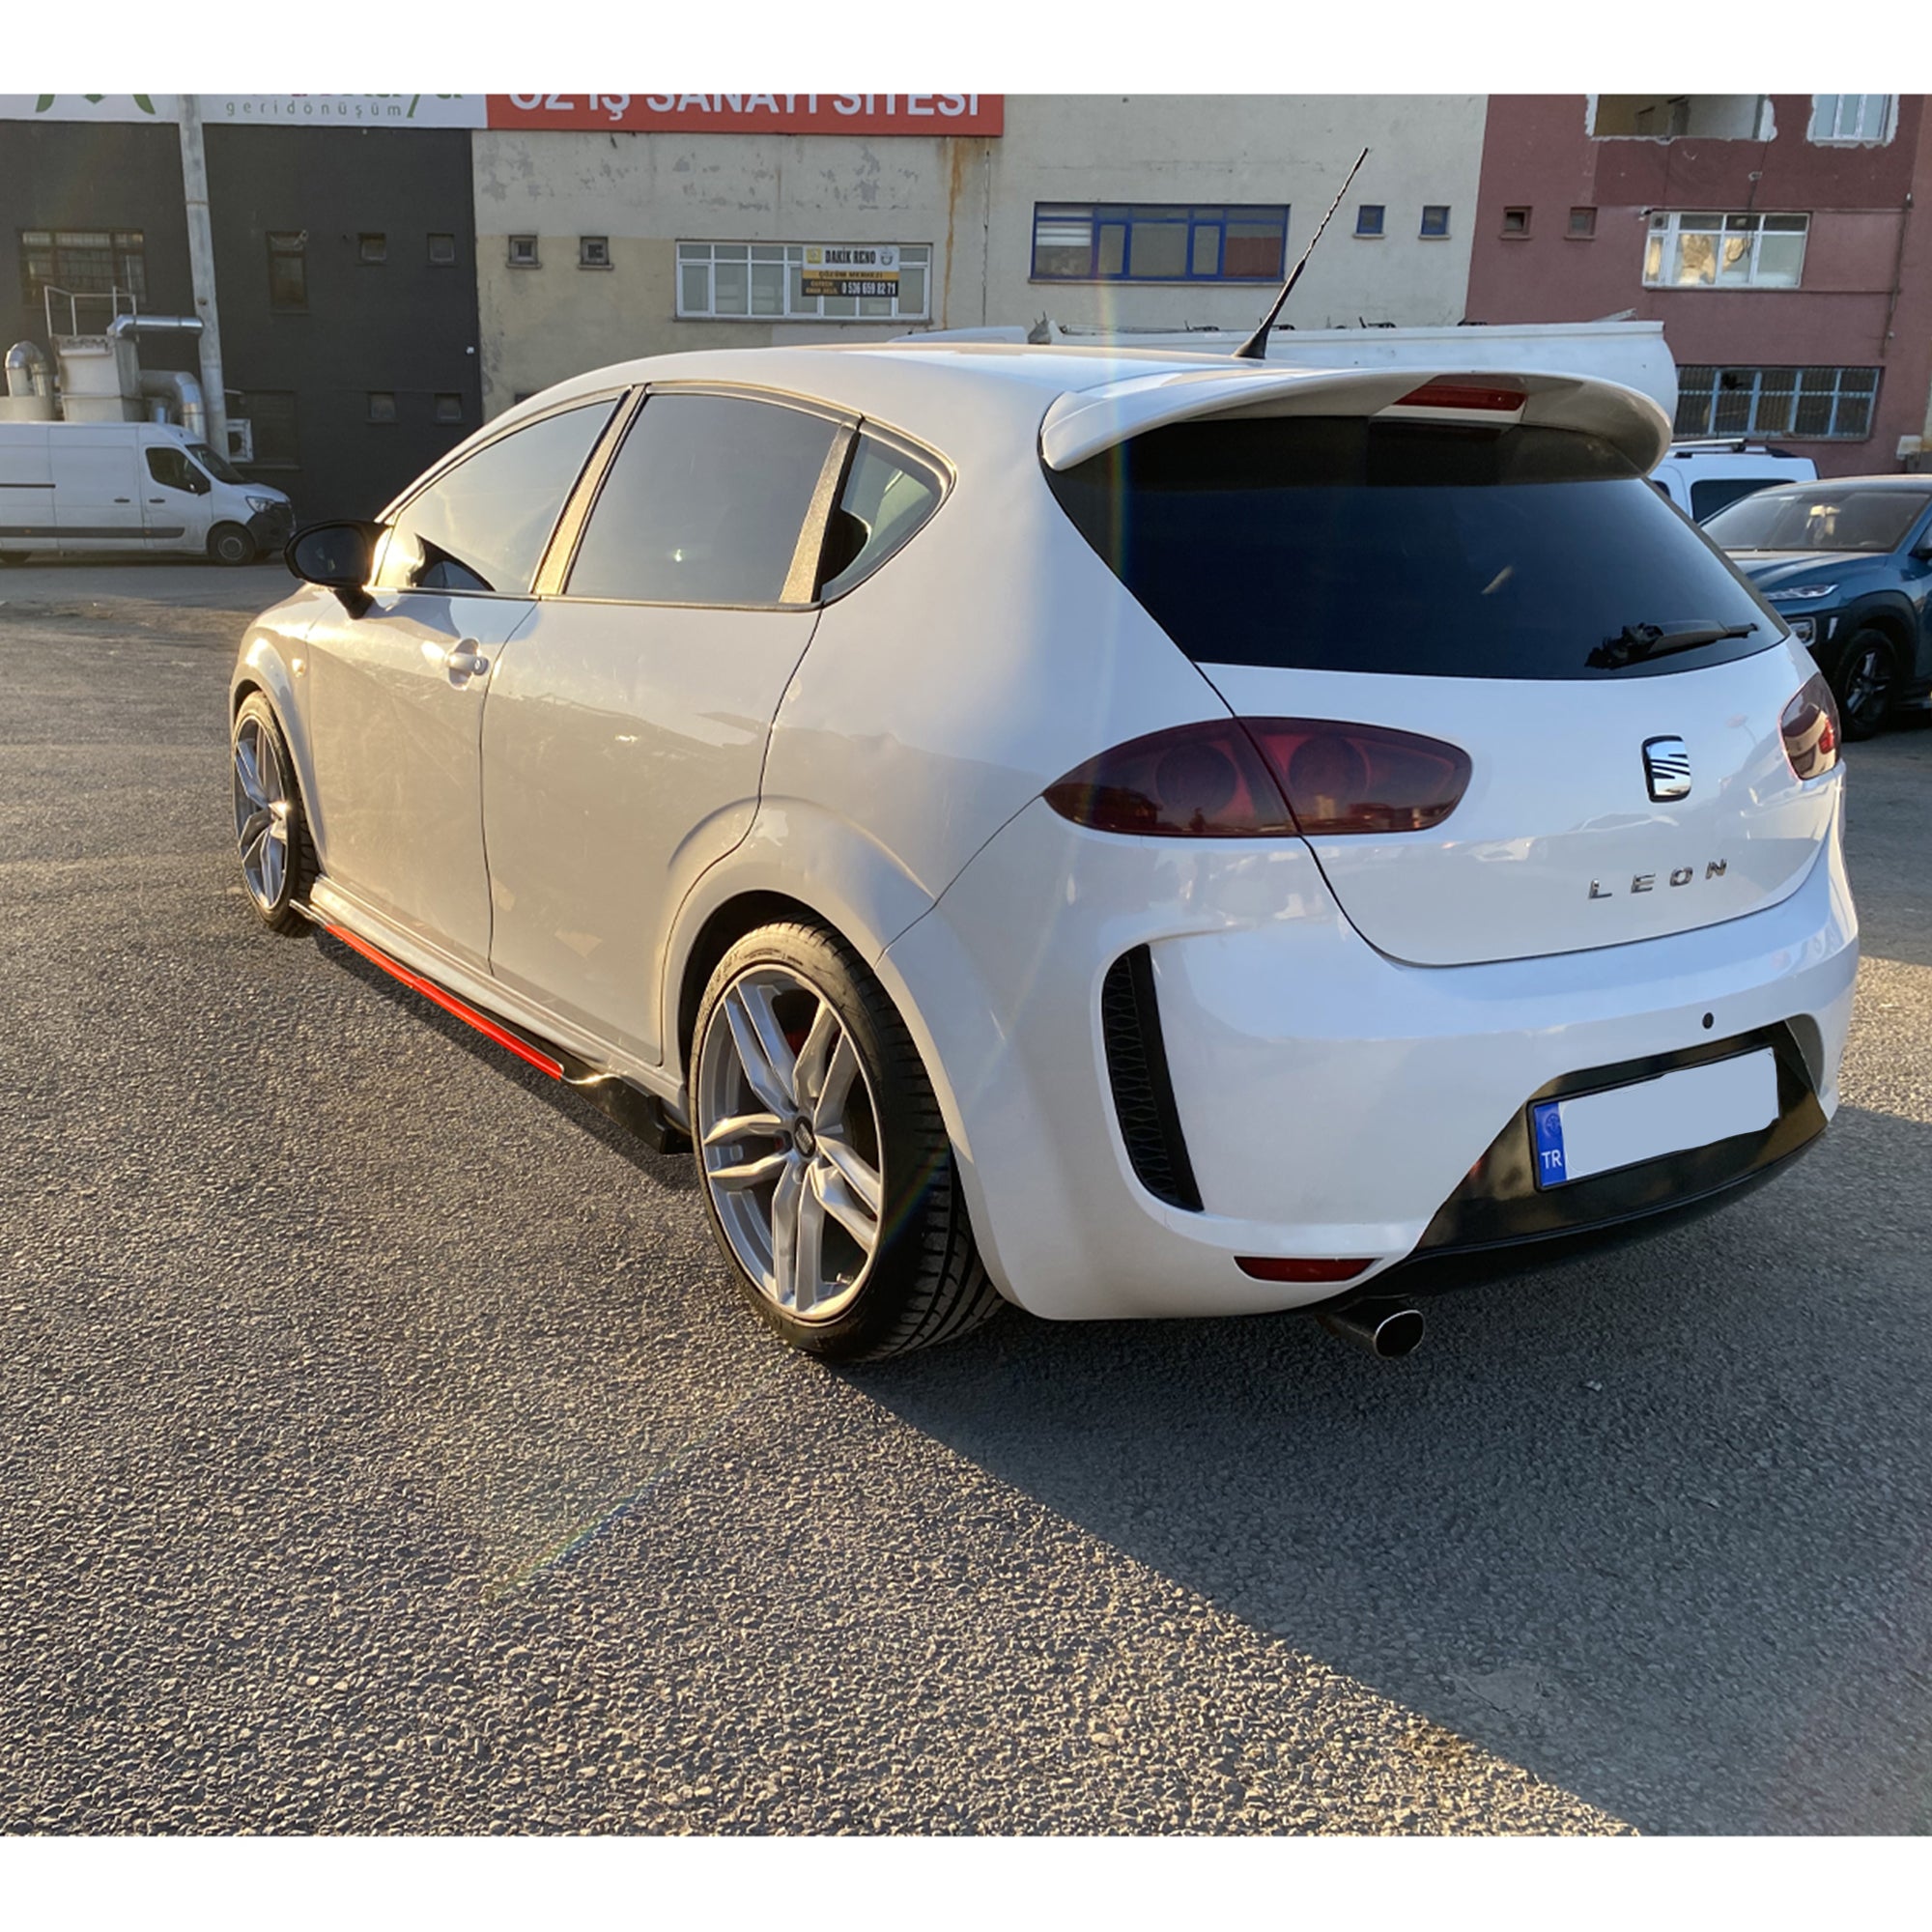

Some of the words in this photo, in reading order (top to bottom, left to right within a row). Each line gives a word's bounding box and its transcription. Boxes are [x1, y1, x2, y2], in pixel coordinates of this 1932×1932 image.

[225, 100, 402, 119] geridönüşüm
[1589, 859, 1727, 899] LEON
[1541, 1149, 1563, 1170] TR
